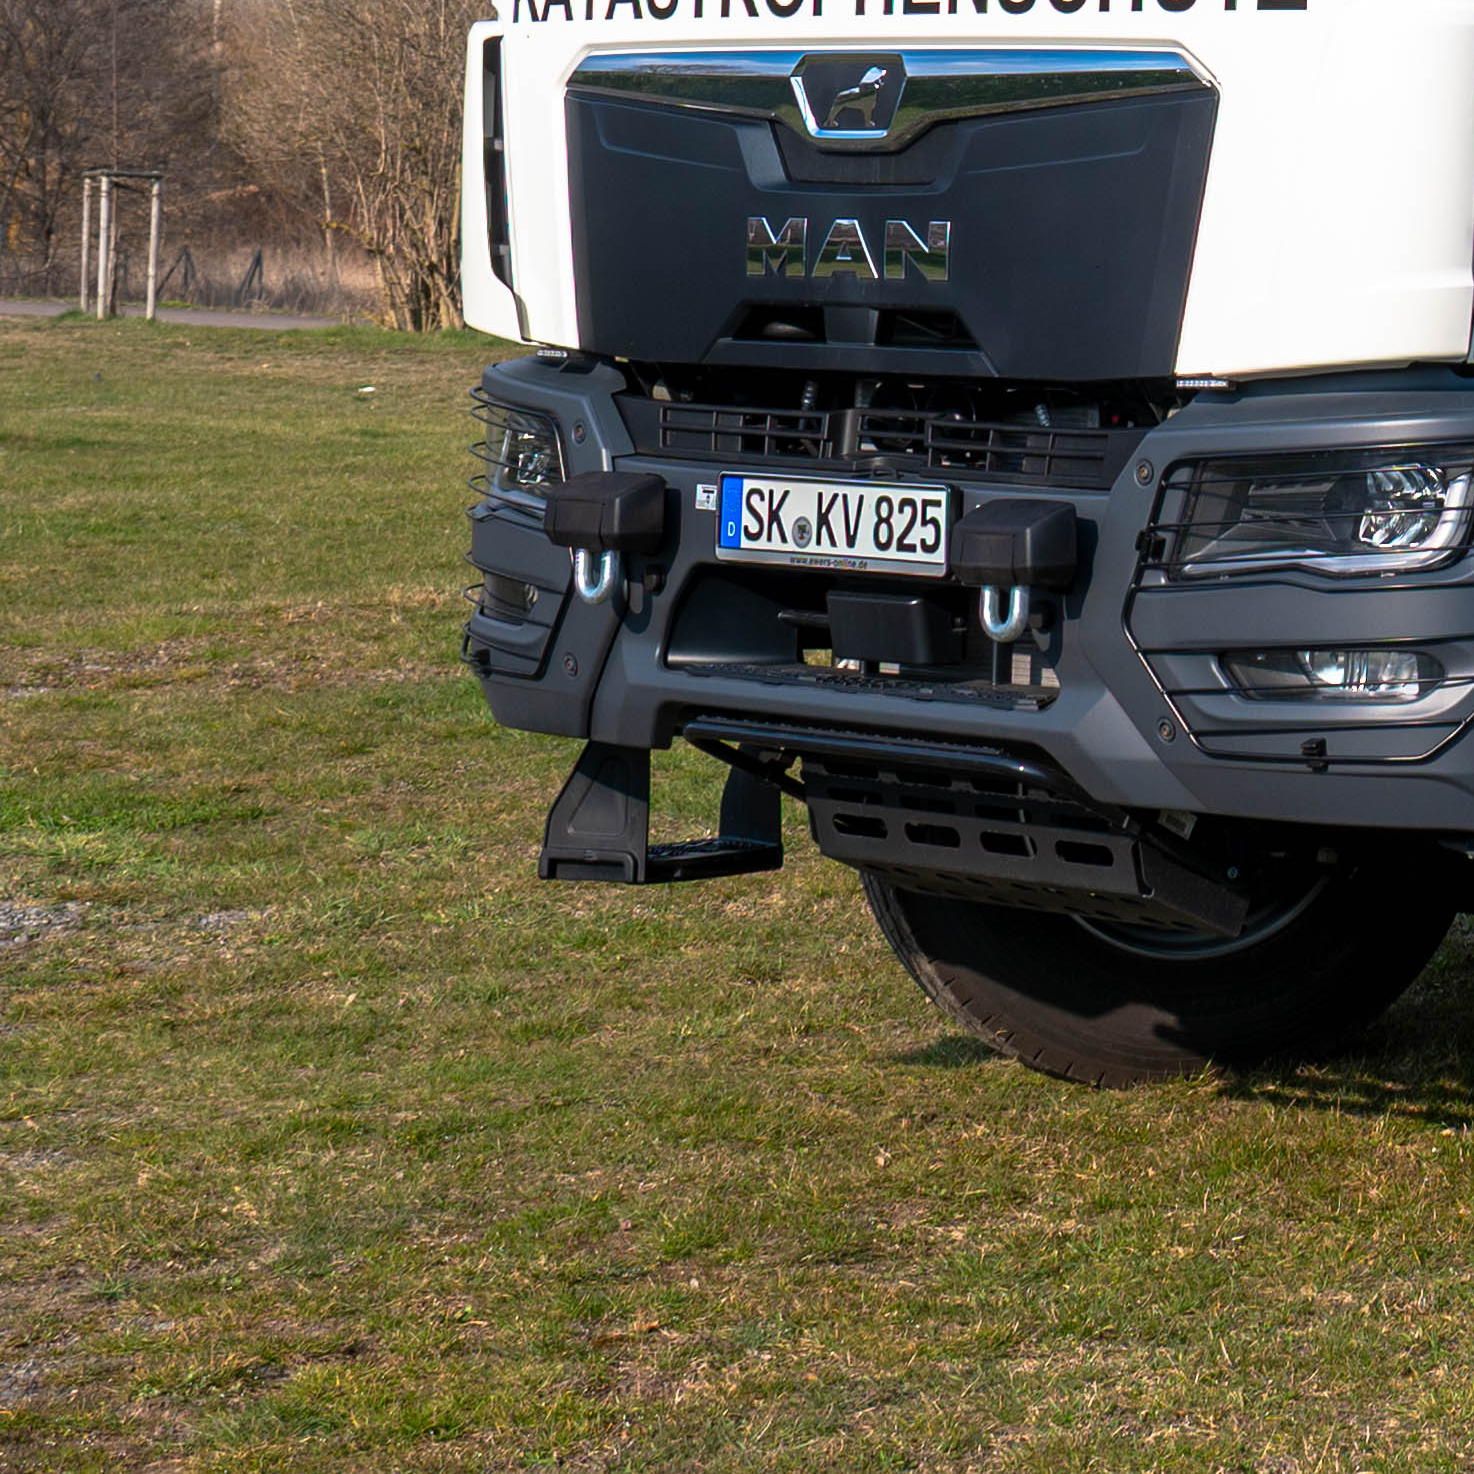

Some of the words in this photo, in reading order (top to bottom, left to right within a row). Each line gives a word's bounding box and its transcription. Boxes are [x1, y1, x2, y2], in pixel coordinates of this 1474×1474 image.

[747, 217, 950, 281] MAN
[727, 521, 736, 537] D
[743, 488, 790, 544] SK
[815, 491, 865, 549] KV
[873, 495, 943, 554] 825
